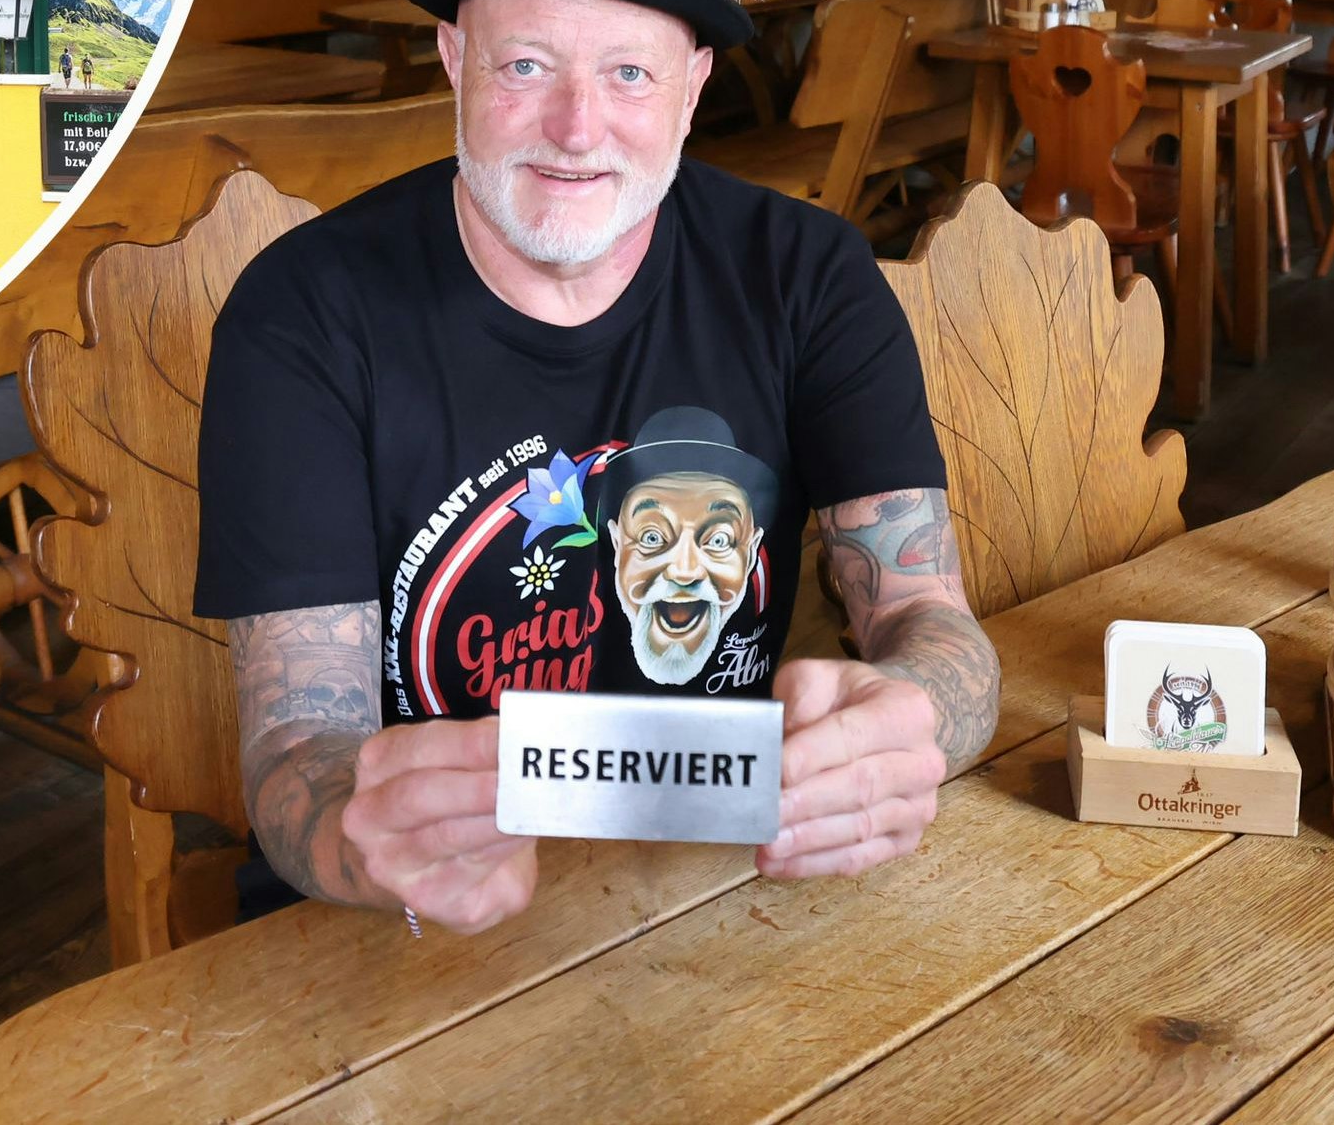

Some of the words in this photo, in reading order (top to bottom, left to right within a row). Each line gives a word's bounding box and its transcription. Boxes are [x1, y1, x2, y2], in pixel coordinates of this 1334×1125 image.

[63, 110, 103, 122] frische
[63, 127, 83, 137] mit
[65, 156, 88, 167] bzw.
[395, 686, 414, 717] Das
[478, 458, 509, 489] seit
[506, 434, 548, 467] 1996
[521, 746, 758, 789] RESERVIERT
[1138, 792, 1241, 820] Ottakringer
